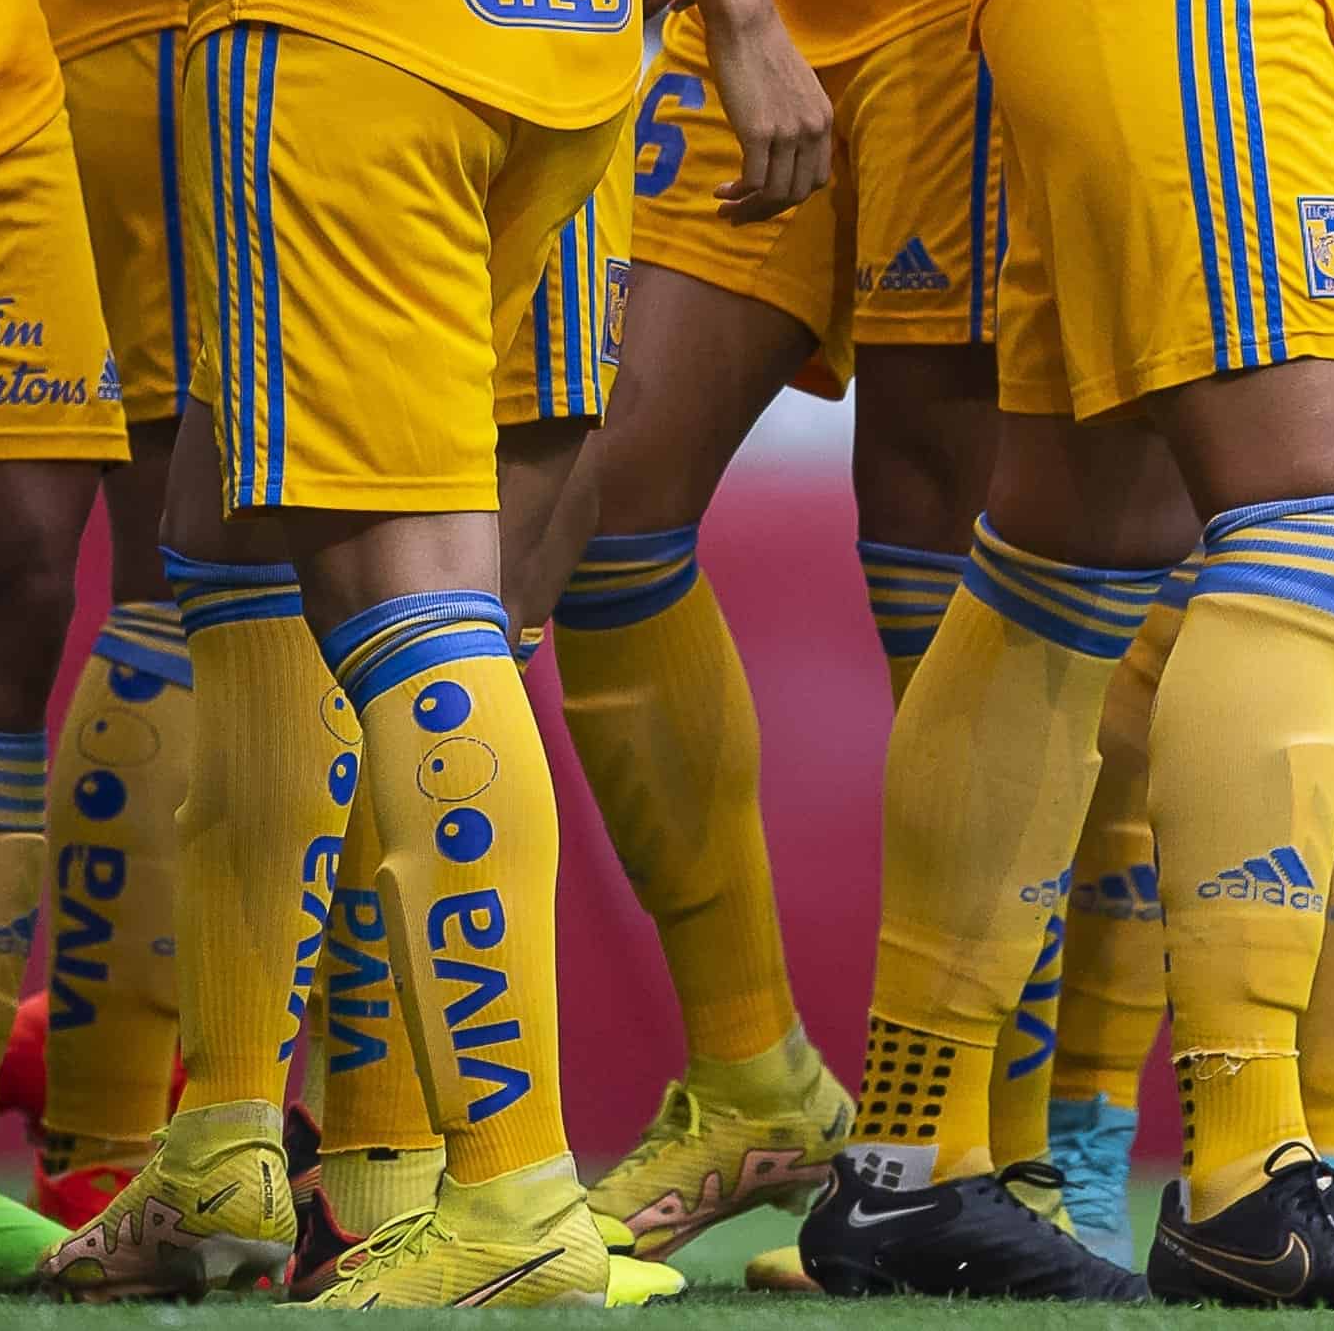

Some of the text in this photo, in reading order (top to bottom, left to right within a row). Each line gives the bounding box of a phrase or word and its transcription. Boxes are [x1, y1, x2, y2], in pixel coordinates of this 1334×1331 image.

[48, 843, 127, 1035] viva
[1197, 875, 1324, 913] adidas
[427, 886, 534, 1124] viva
